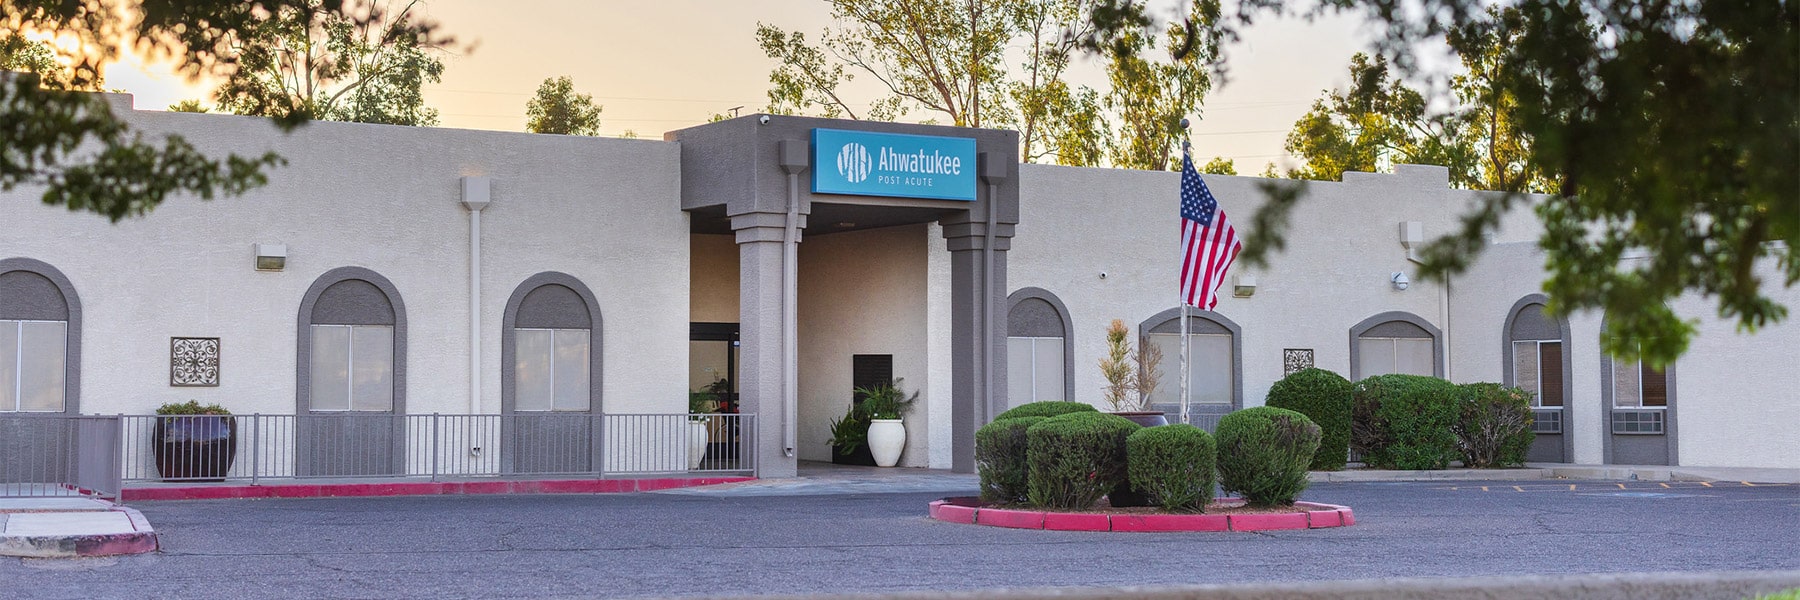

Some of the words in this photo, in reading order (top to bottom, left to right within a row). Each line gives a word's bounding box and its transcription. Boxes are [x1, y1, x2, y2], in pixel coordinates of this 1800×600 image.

[878, 146, 961, 175] Ahwatukee
[878, 175, 900, 185] POST
[905, 177, 933, 187] ACUTE
